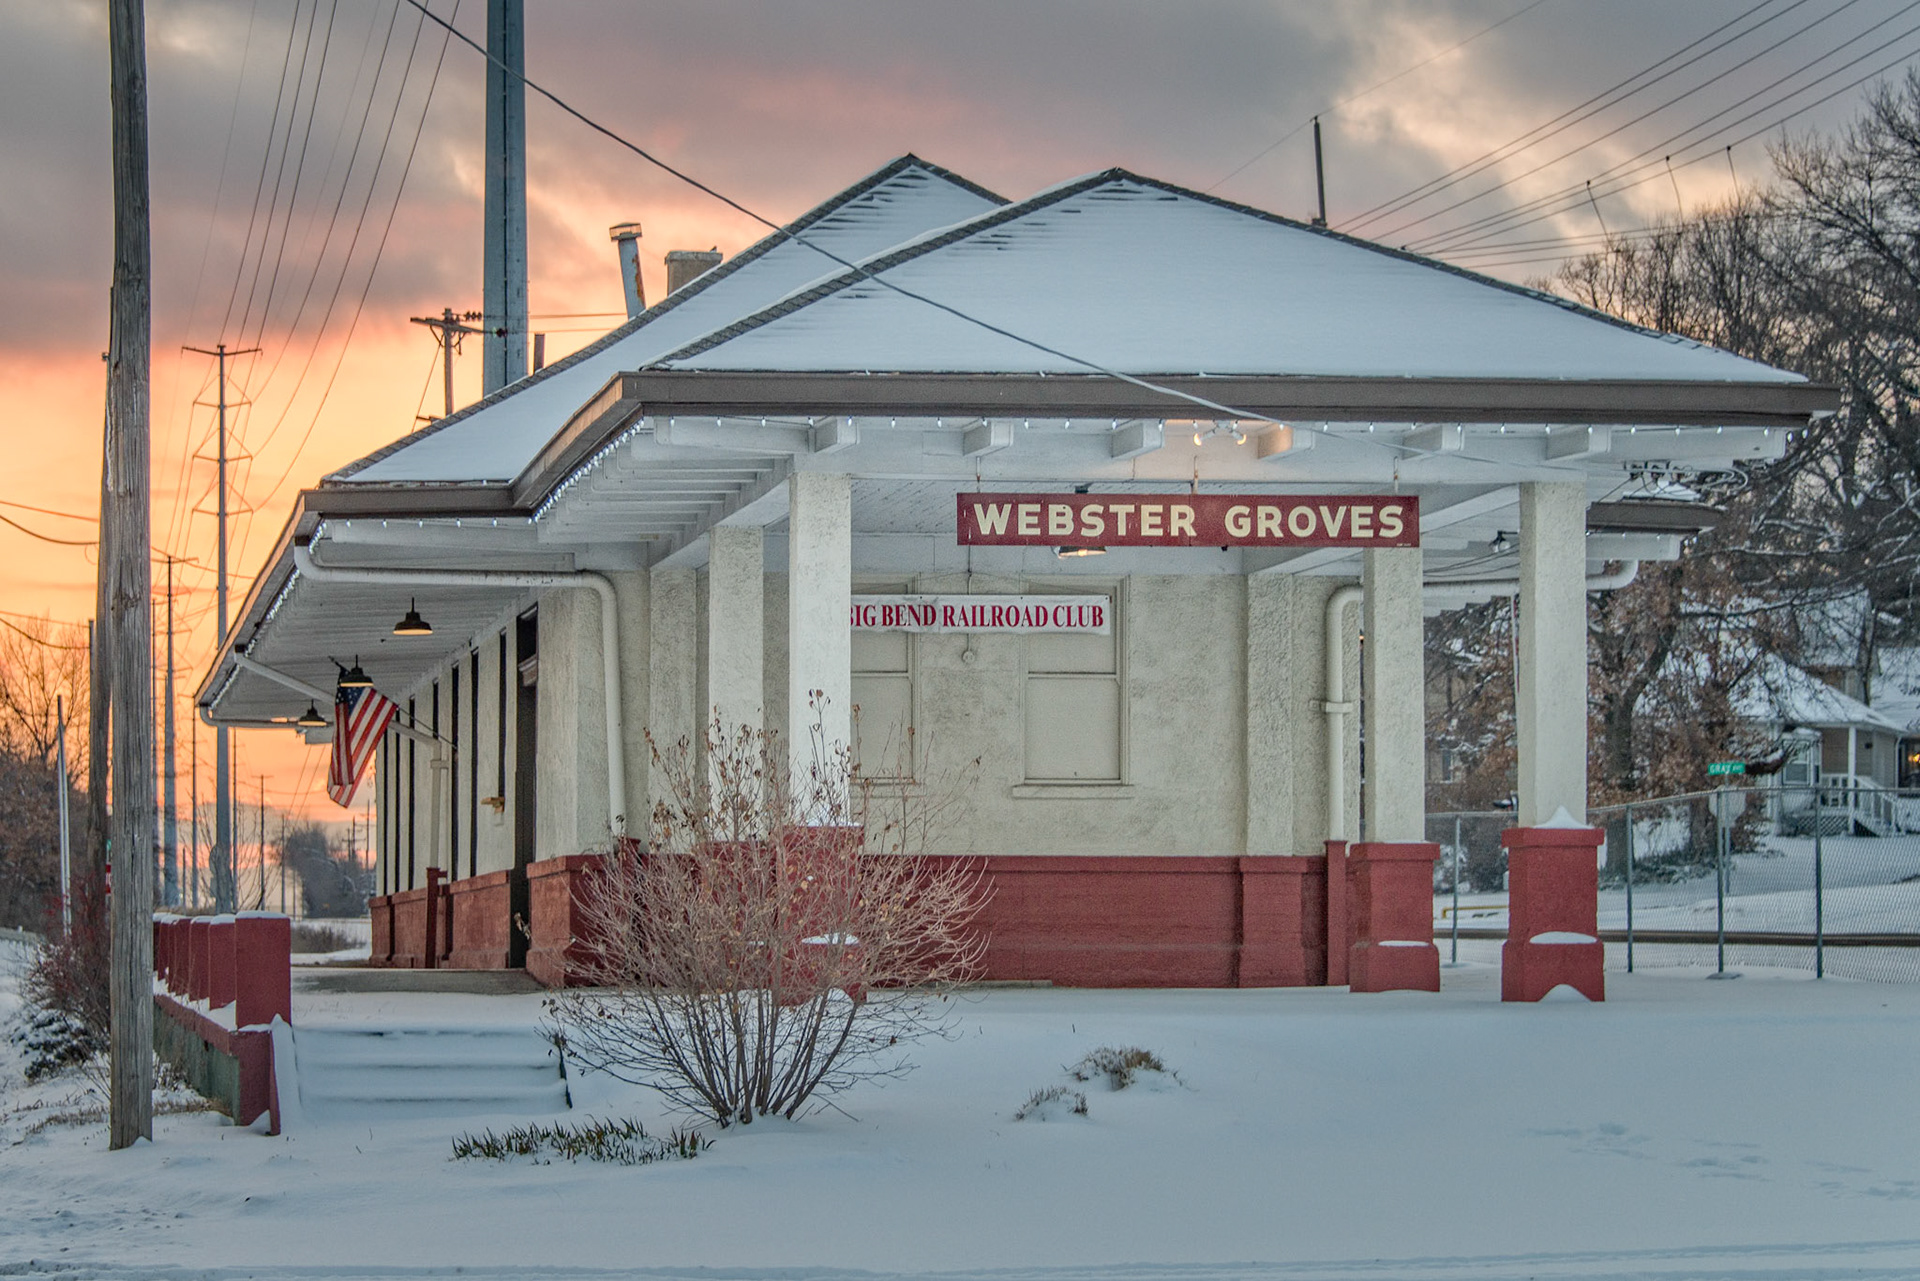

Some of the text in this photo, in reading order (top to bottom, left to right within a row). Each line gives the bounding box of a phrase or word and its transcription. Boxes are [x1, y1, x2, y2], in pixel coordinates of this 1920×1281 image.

[973, 503, 1404, 538] WEBSTER GROVES
[881, 604, 937, 627] BEND
[942, 604, 1049, 628] RAILROAD
[1052, 604, 1104, 628] CLUB
